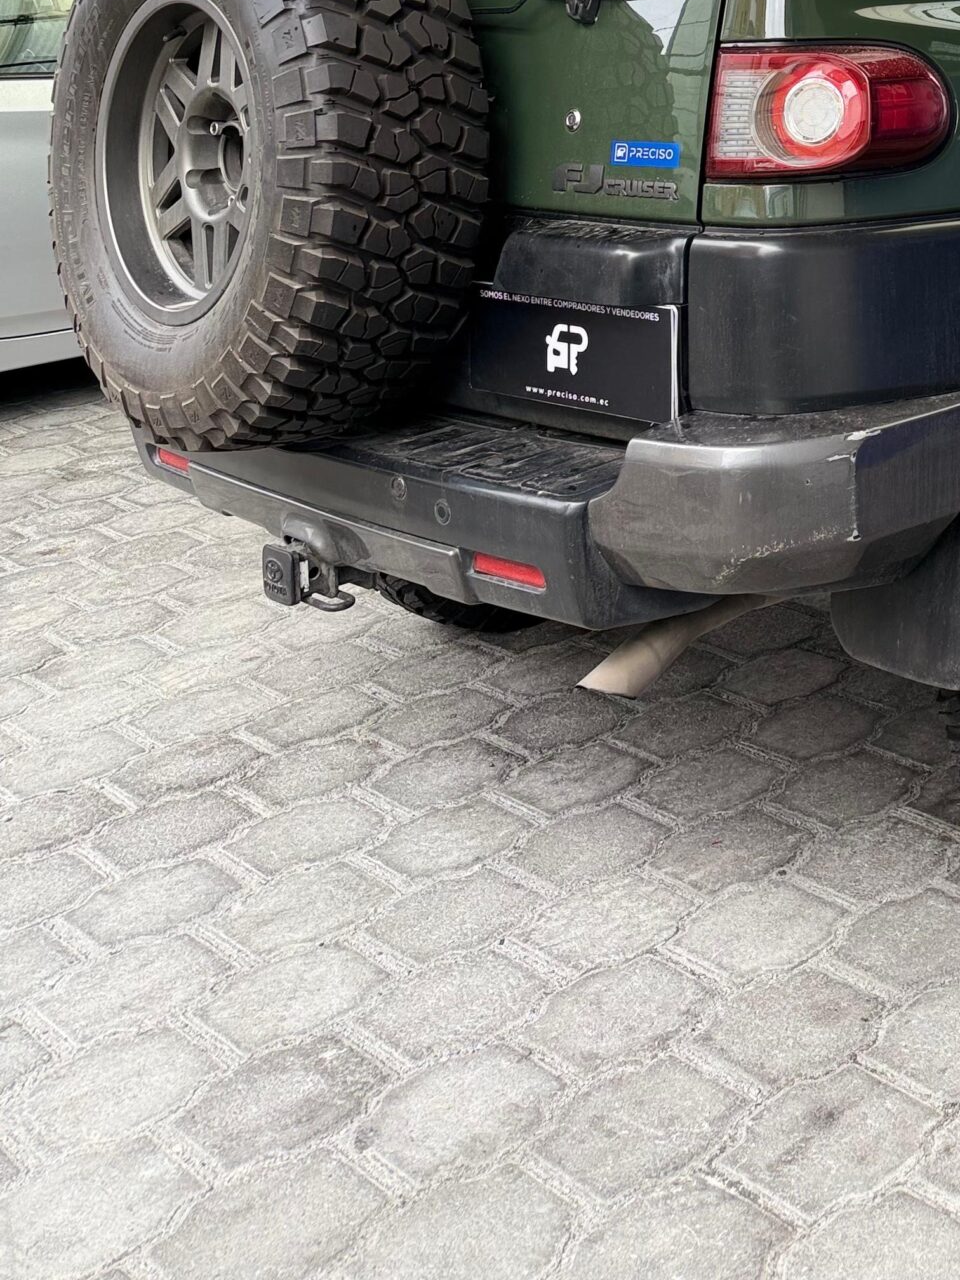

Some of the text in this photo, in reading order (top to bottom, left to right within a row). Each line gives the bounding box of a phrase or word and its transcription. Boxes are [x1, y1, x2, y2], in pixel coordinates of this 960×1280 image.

[629, 147, 674, 160] PRECISO
[551, 163, 680, 201] FJ CRUISER
[479, 289, 503, 300] SOMOS
[503, 292, 511, 301] EL
[512, 294, 530, 304] NEXO
[531, 296, 552, 307] ENTRE
[553, 299, 605, 314] COMPRADORES
[611, 307, 660, 322] VENDEDORES
[525, 385, 609, 407] www.preciso.com.ec
